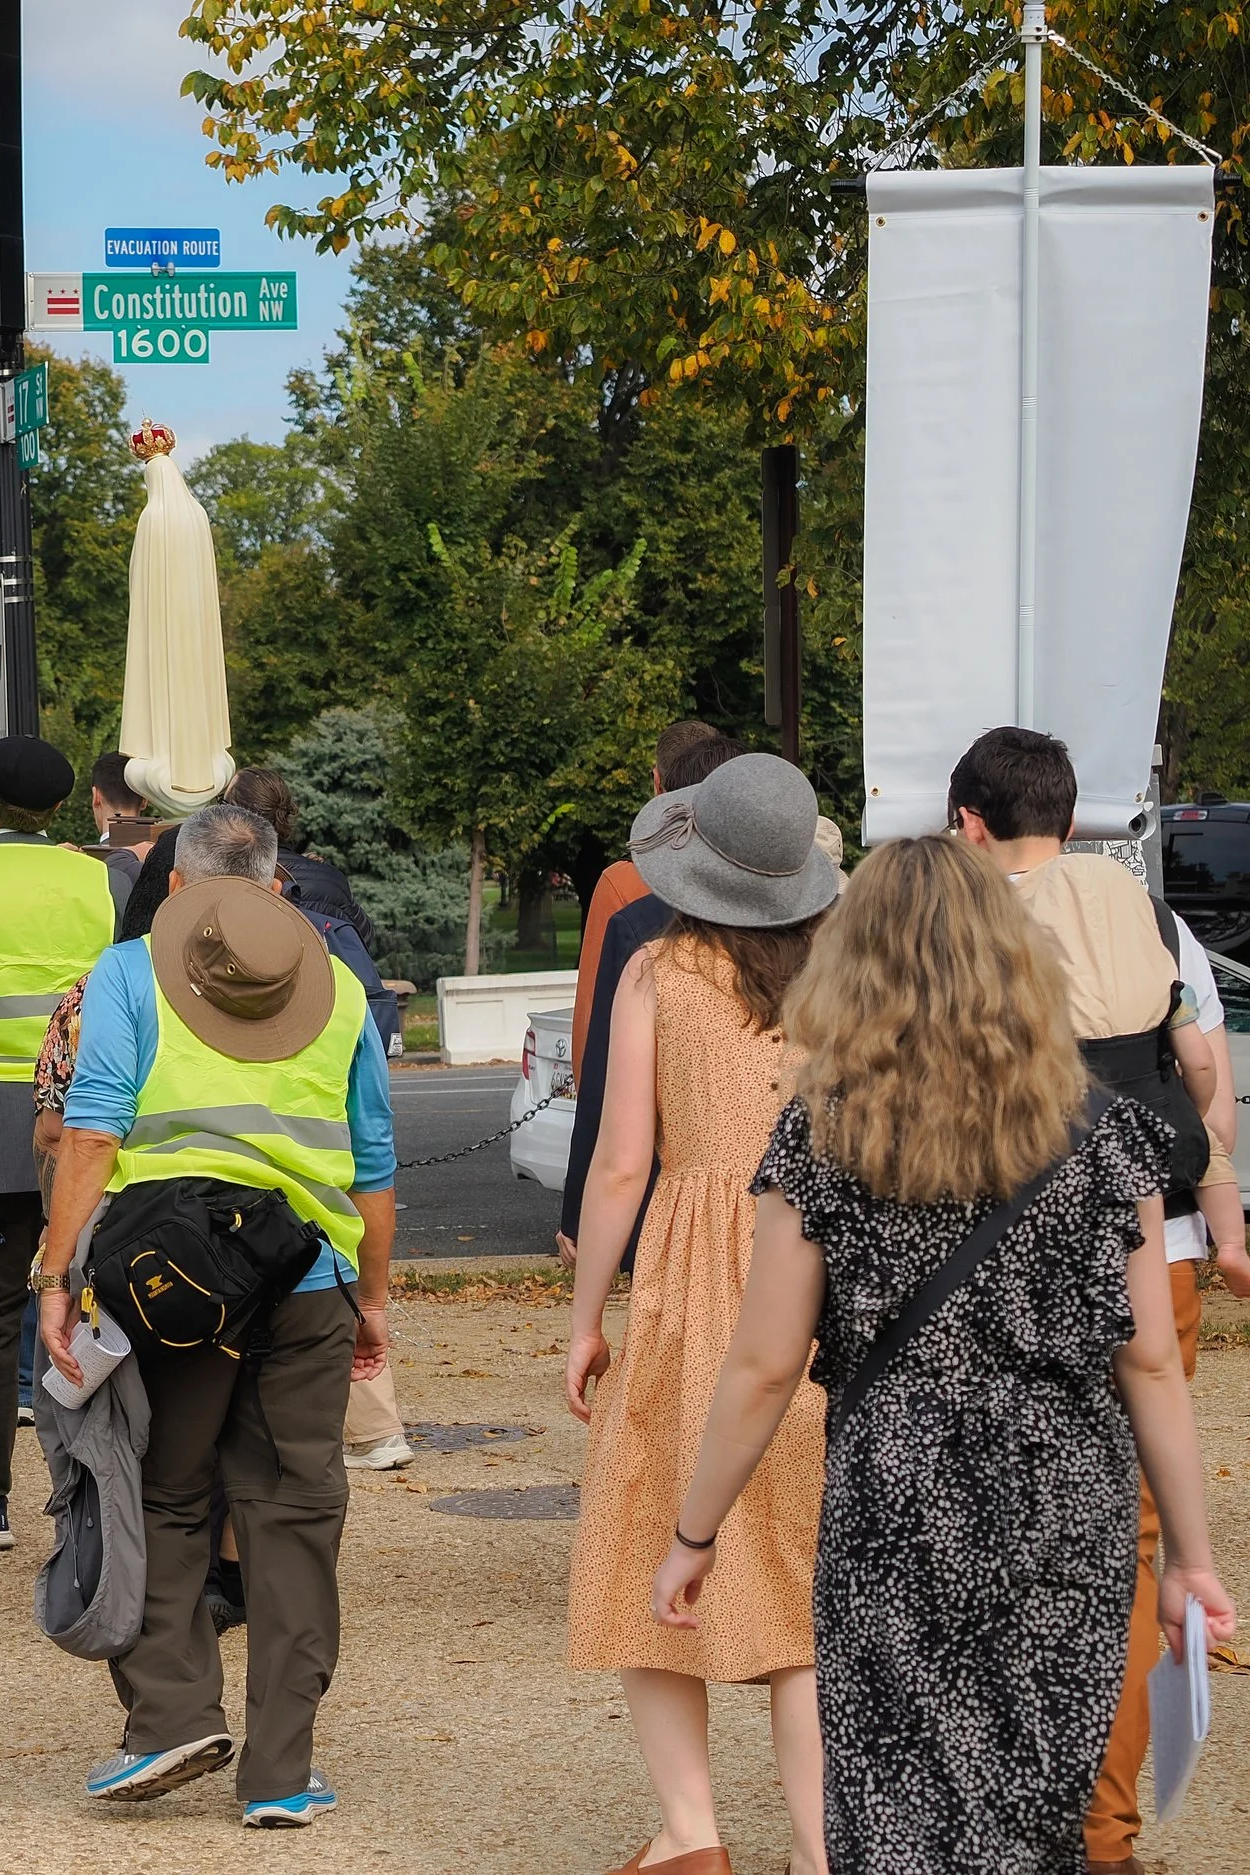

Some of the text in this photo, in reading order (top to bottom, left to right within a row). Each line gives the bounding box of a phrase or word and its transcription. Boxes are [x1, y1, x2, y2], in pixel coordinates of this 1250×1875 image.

[107, 240, 219, 255] EVACUATION ROUTE
[93, 283, 248, 320] Constitution
[259, 277, 288, 299] Ave
[259, 300, 284, 321] NW
[117, 329, 208, 358] 1600
[18, 380, 29, 426] 17
[20, 431, 36, 463] 100
